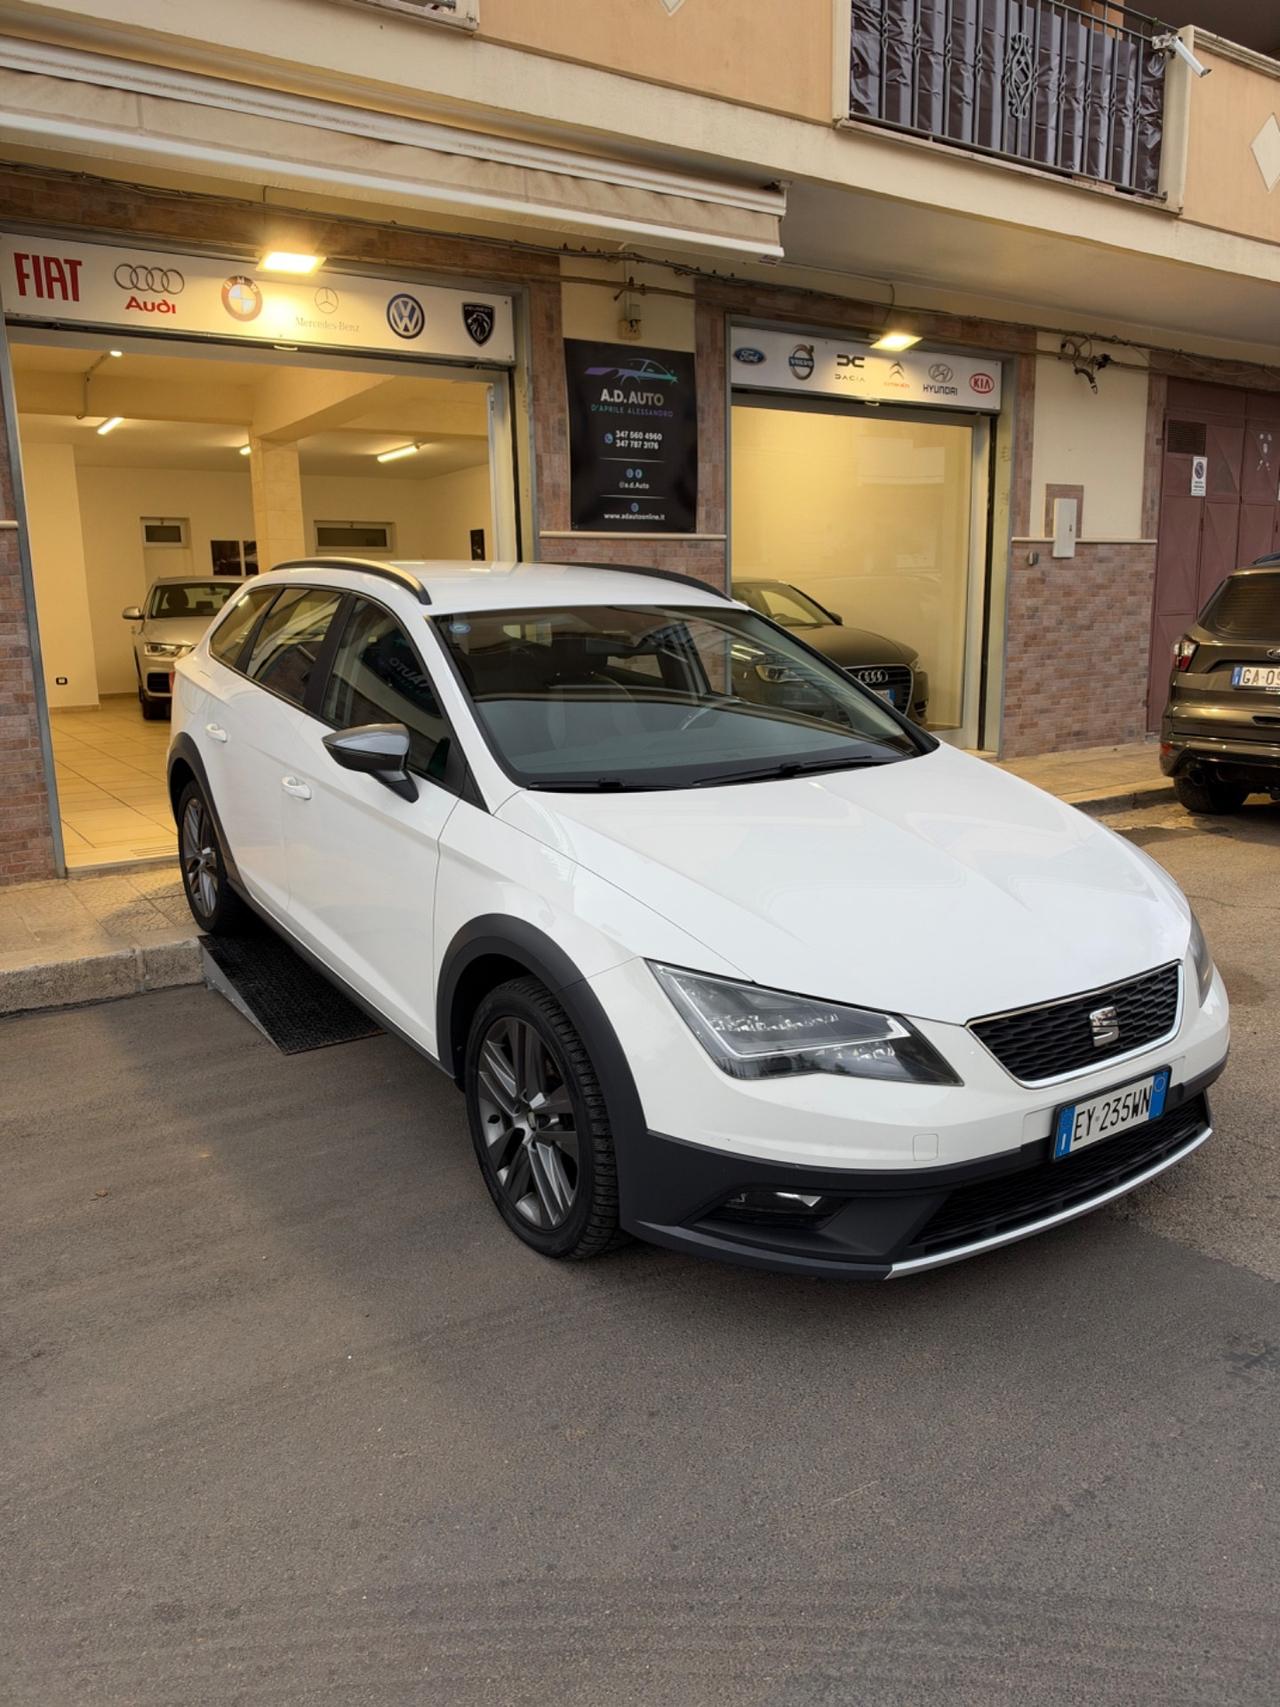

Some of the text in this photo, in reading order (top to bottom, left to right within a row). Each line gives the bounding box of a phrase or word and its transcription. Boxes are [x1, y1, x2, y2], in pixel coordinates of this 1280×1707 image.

[13, 252, 82, 302] FIAT
[125, 296, 177, 314] Audi
[295, 317, 360, 331] Mercedes-Benz
[923, 384, 958, 396] HYUNDAI
[973, 377, 990, 390] KIA
[616, 430, 629, 438] 347
[616, 439, 629, 448] 347
